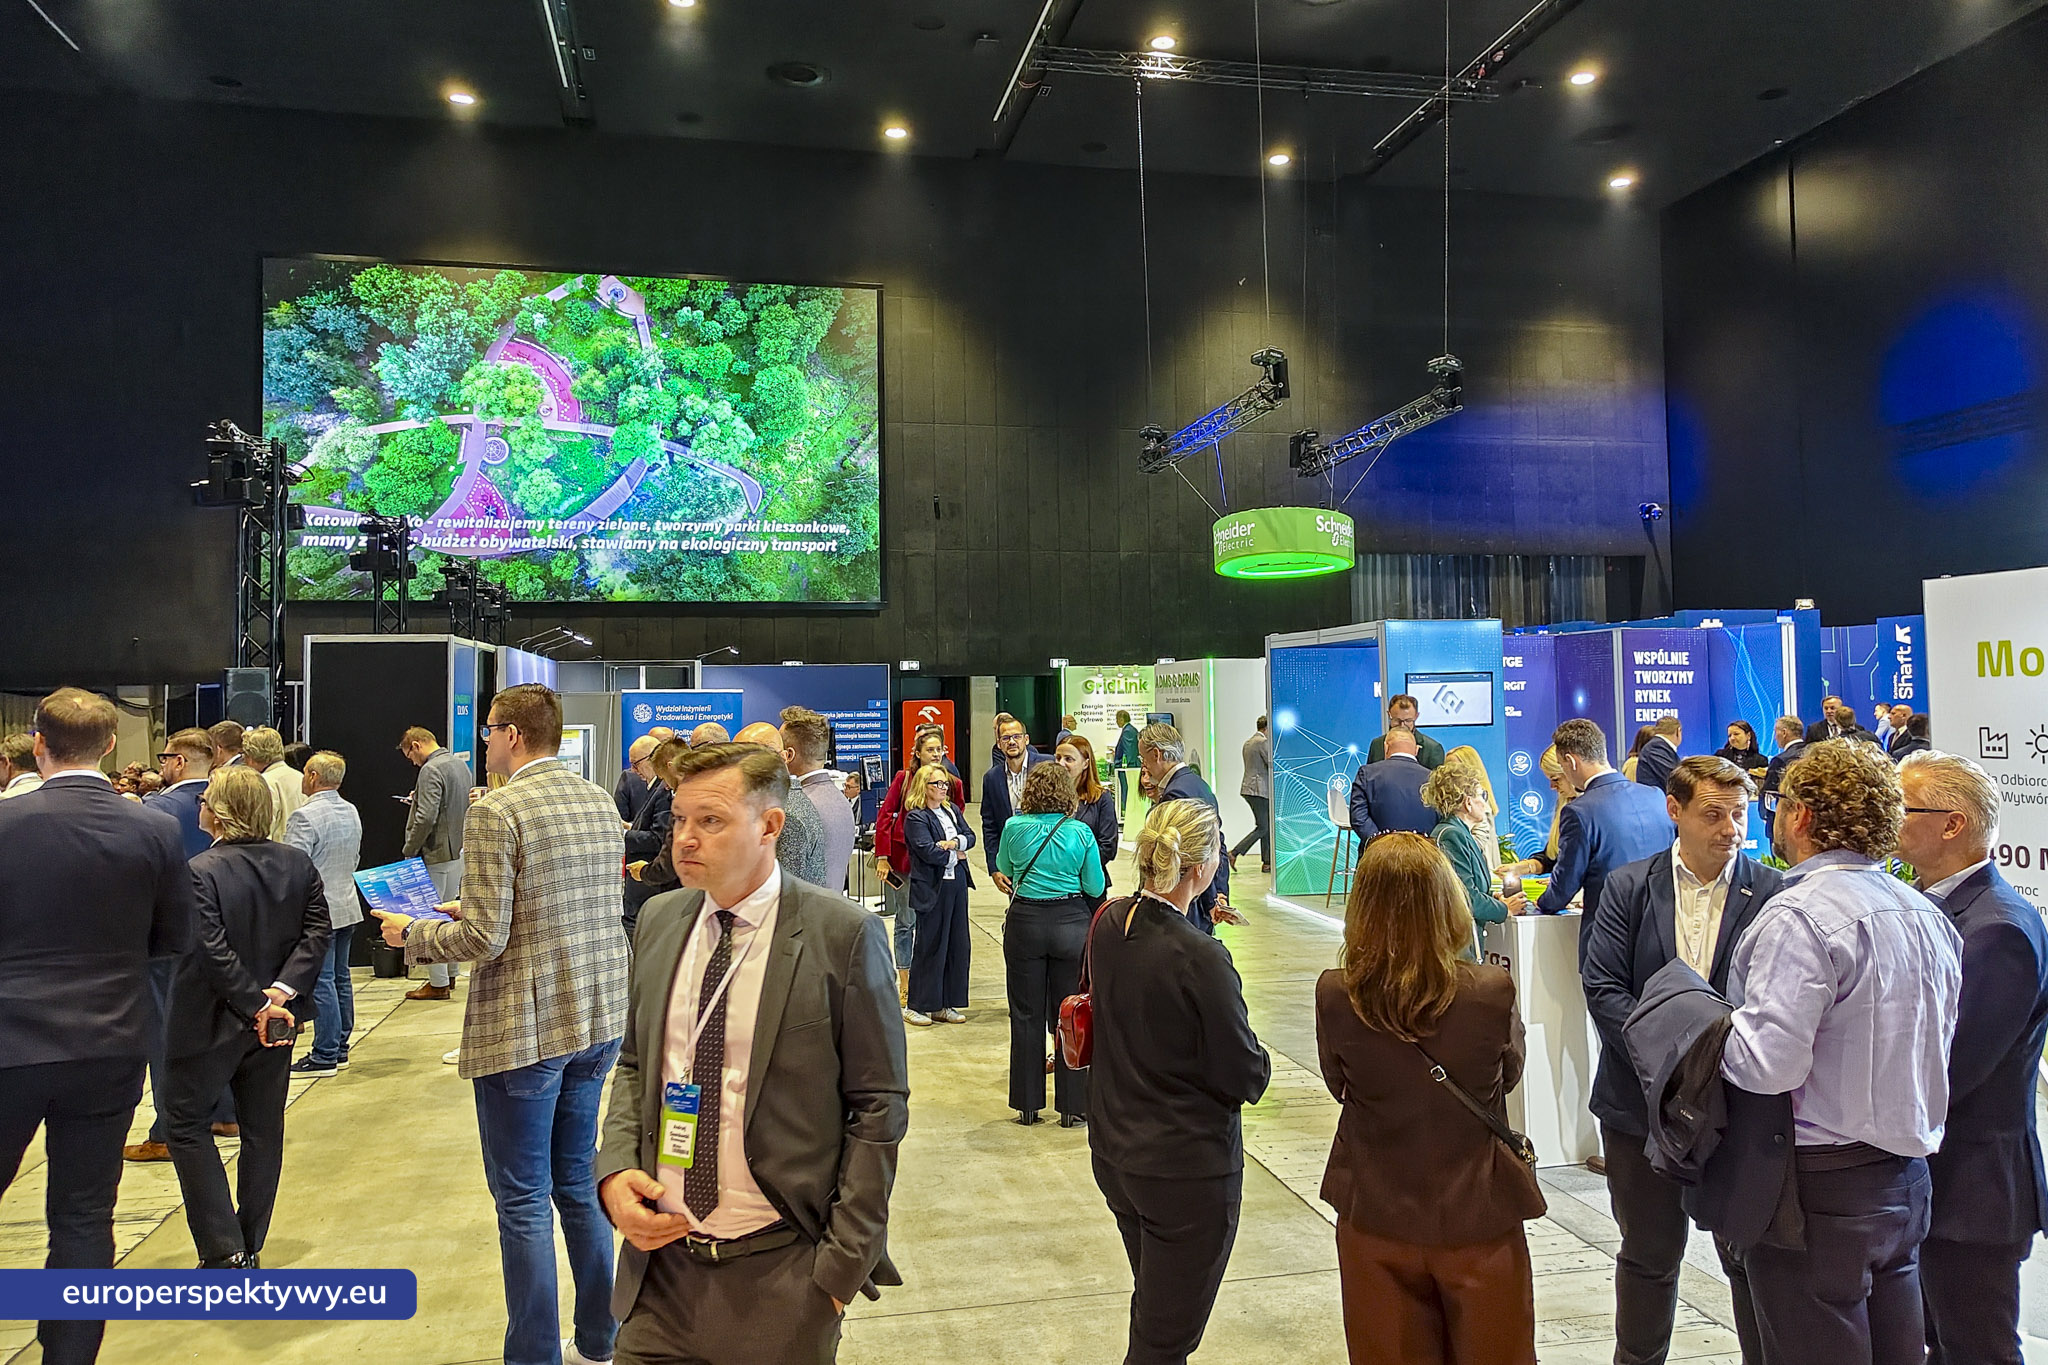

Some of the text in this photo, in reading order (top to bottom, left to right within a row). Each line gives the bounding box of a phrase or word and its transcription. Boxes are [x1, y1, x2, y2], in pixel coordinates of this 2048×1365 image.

[437, 515, 545, 532] rewitalizujemy
[548, 517, 596, 532] tereny
[598, 518, 651, 532] zielone,
[655, 519, 723, 534] tworzymy
[725, 519, 761, 534] parki
[762, 520, 851, 536] kieszonkowe,
[1315, 515, 1354, 538] Schneide
[302, 533, 357, 550] mamy
[421, 533, 477, 549] budżet
[479, 534, 578, 551] obywatelski,
[581, 537, 657, 552] stawiamy
[659, 539, 679, 550] na
[681, 537, 769, 554] ekologiczny
[772, 539, 838, 555] transport
[1633, 648, 1690, 666] WSPÓLNIE
[1978, 640, 2045, 678] Mo
[1634, 670, 1694, 685] TWORZYMY
[1896, 646, 1913, 699] Shaft
[1084, 678, 1148, 693] GridLink
[1635, 689, 1672, 703] RYNEK
[655, 704, 712, 714] Wydział Inżynierii
[655, 712, 694, 721] Środowiska
[698, 712, 734, 722] Energetyki
[674, 729, 694, 737] Polite
[2000, 773, 2048, 788] Odbiorc
[2000, 790, 2048, 807] Wytwór
